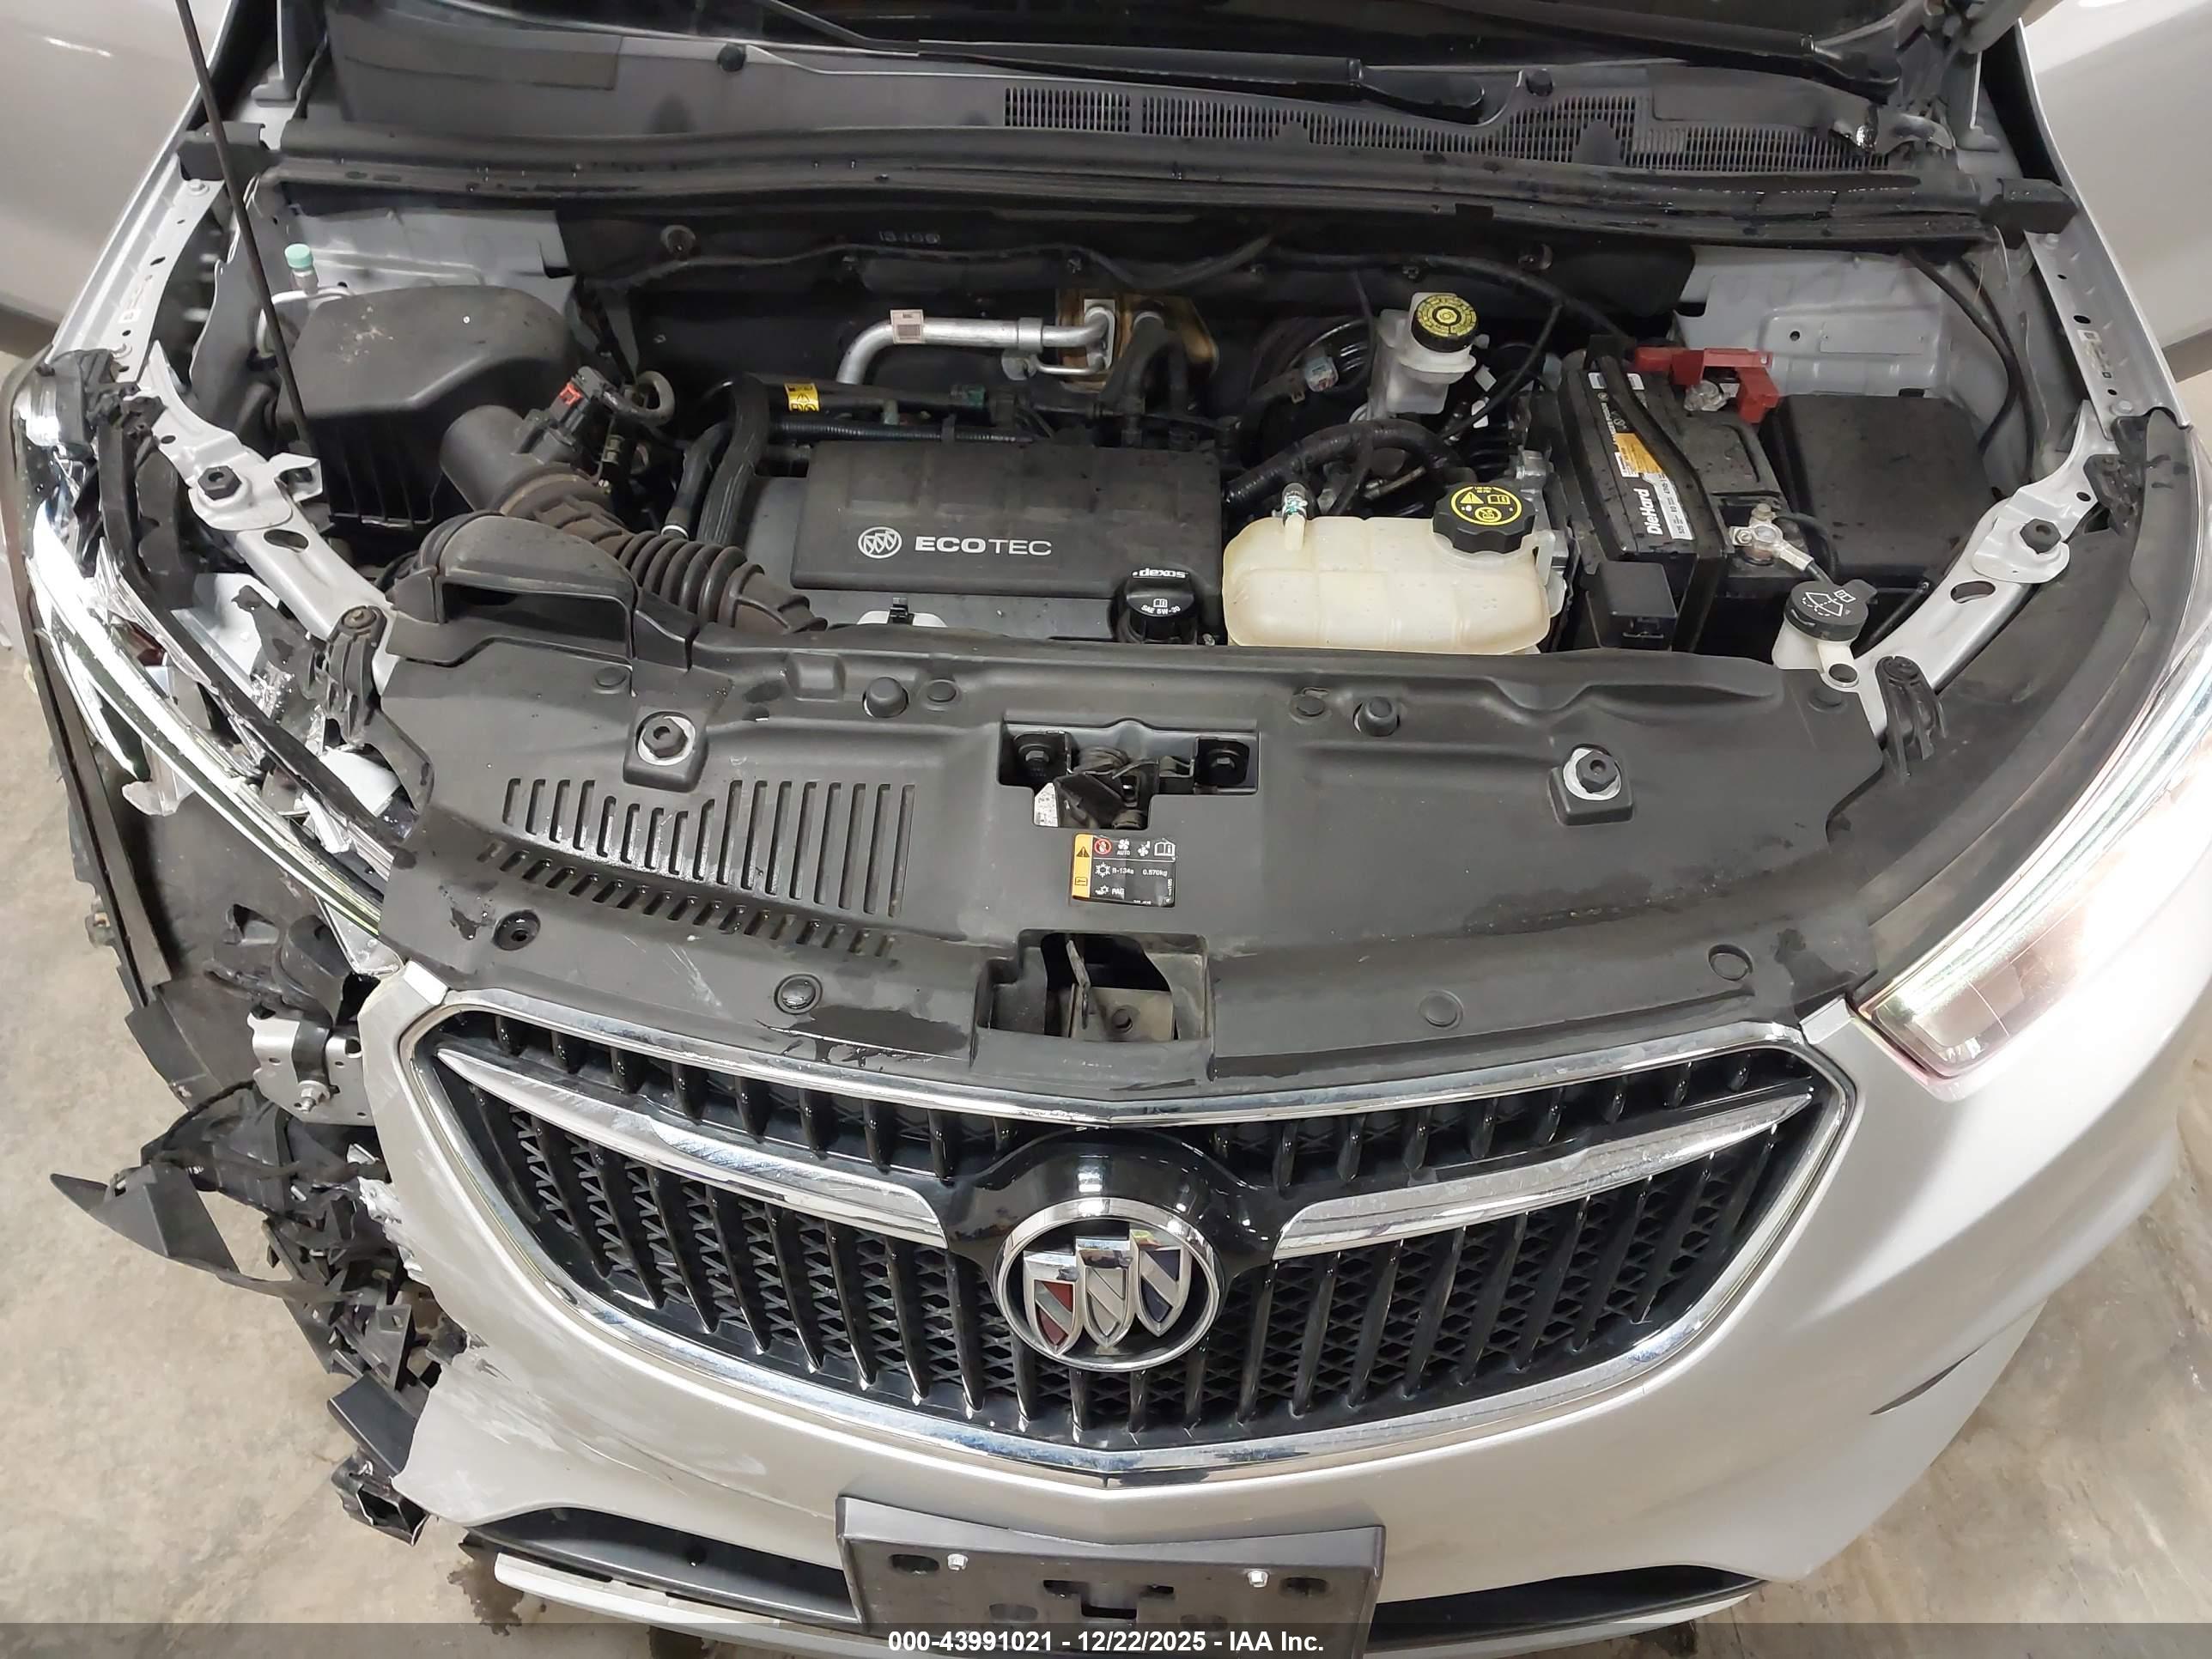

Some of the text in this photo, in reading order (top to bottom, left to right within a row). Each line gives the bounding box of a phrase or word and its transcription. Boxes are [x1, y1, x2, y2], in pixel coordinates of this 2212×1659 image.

[1633, 488, 1663, 535] DieHard
[915, 536, 1052, 556] ECOTEC
[1139, 568, 1186, 579] dexos
[1140, 605, 1182, 615] SAE 5W-30
